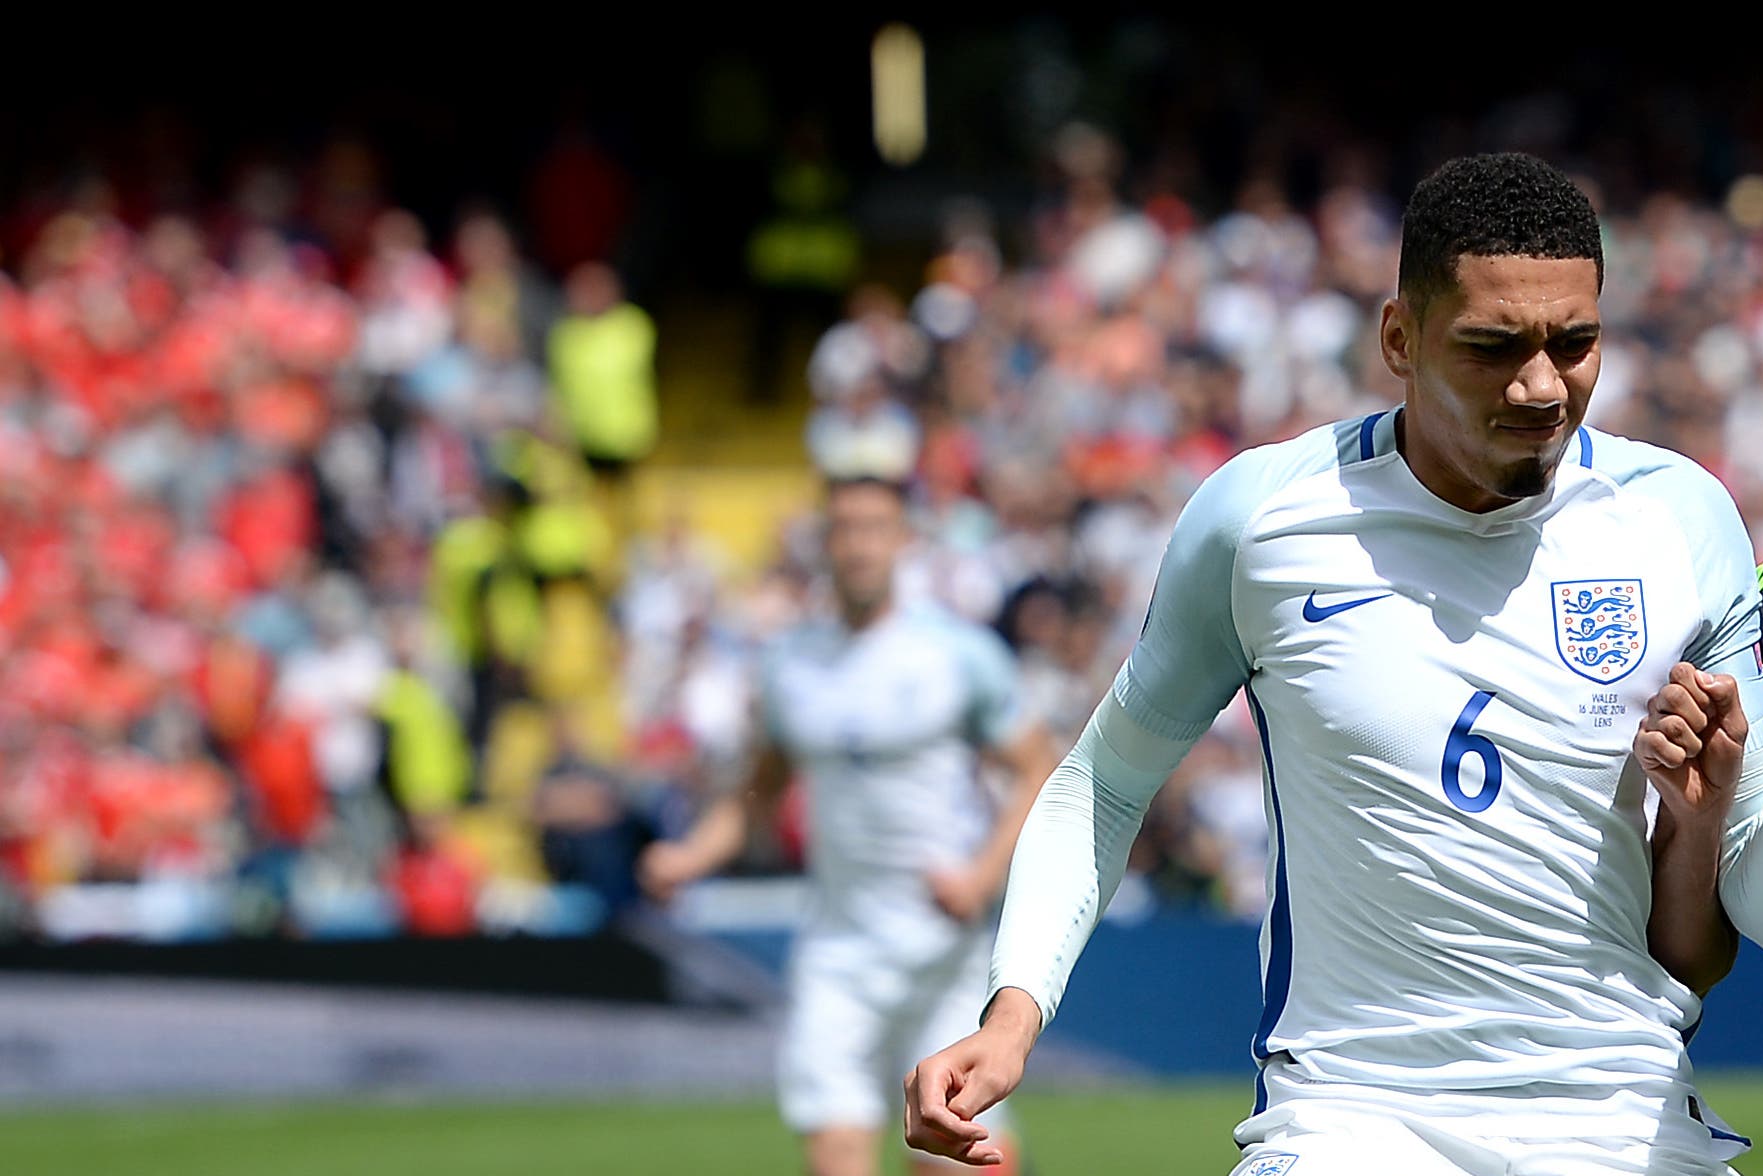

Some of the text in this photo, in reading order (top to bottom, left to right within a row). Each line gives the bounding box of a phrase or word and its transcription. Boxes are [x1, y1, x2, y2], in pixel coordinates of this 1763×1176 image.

[1592, 694, 1618, 703] WALES
[1579, 705, 1586, 714] 16
[1589, 705, 1608, 715] JUNE
[1594, 717, 1612, 727] LENS
[1440, 690, 1503, 813] 6
